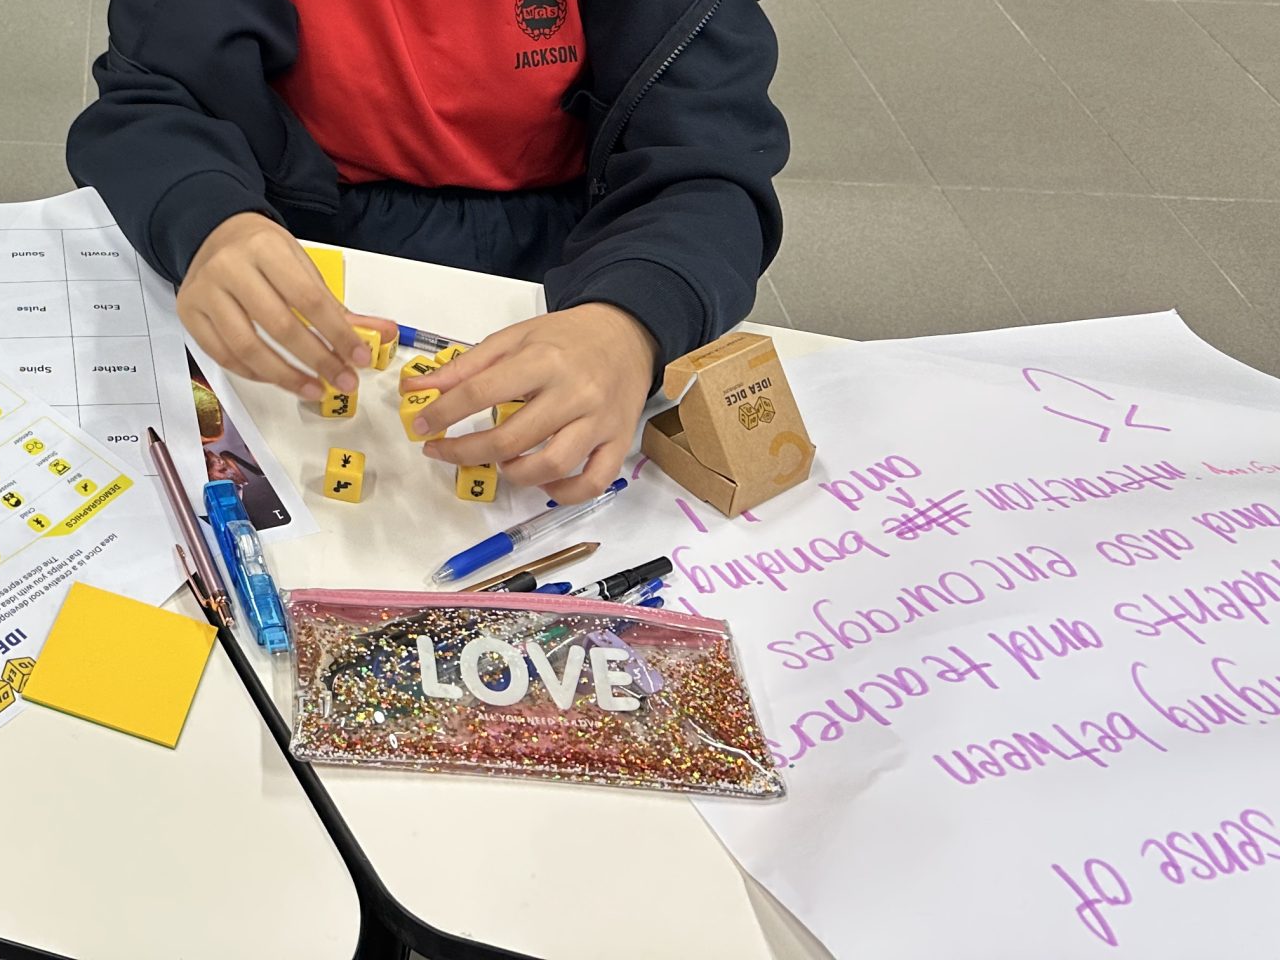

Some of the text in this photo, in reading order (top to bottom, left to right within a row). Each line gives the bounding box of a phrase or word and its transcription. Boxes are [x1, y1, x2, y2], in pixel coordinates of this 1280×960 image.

[515, 44, 578, 70] JACKSON
[20, 365, 52, 373] Spine
[748, 377, 773, 396] IDEA
[724, 388, 748, 407] DICE
[107, 435, 138, 443] Code
[818, 455, 920, 512] and
[62, 483, 123, 528] DEMOGRAPHICS
[80, 545, 103, 560] Dice
[1095, 526, 1194, 568] also
[41, 556, 58, 567] The
[65, 549, 84, 563] that
[76, 559, 86, 567] is
[671, 530, 890, 597] bonding
[21, 565, 44, 581] dices
[46, 559, 69, 576] helps
[32, 572, 48, 586] you
[42, 569, 73, 591] creative
[16, 583, 35, 597] with
[27, 589, 45, 602] tool
[0, 594, 19, 608] idea
[986, 615, 1104, 681] and
[415, 634, 641, 711] LOVE
[527, 716, 555, 726] NEED
[932, 709, 1167, 787] between
[1050, 857, 1133, 948] of
